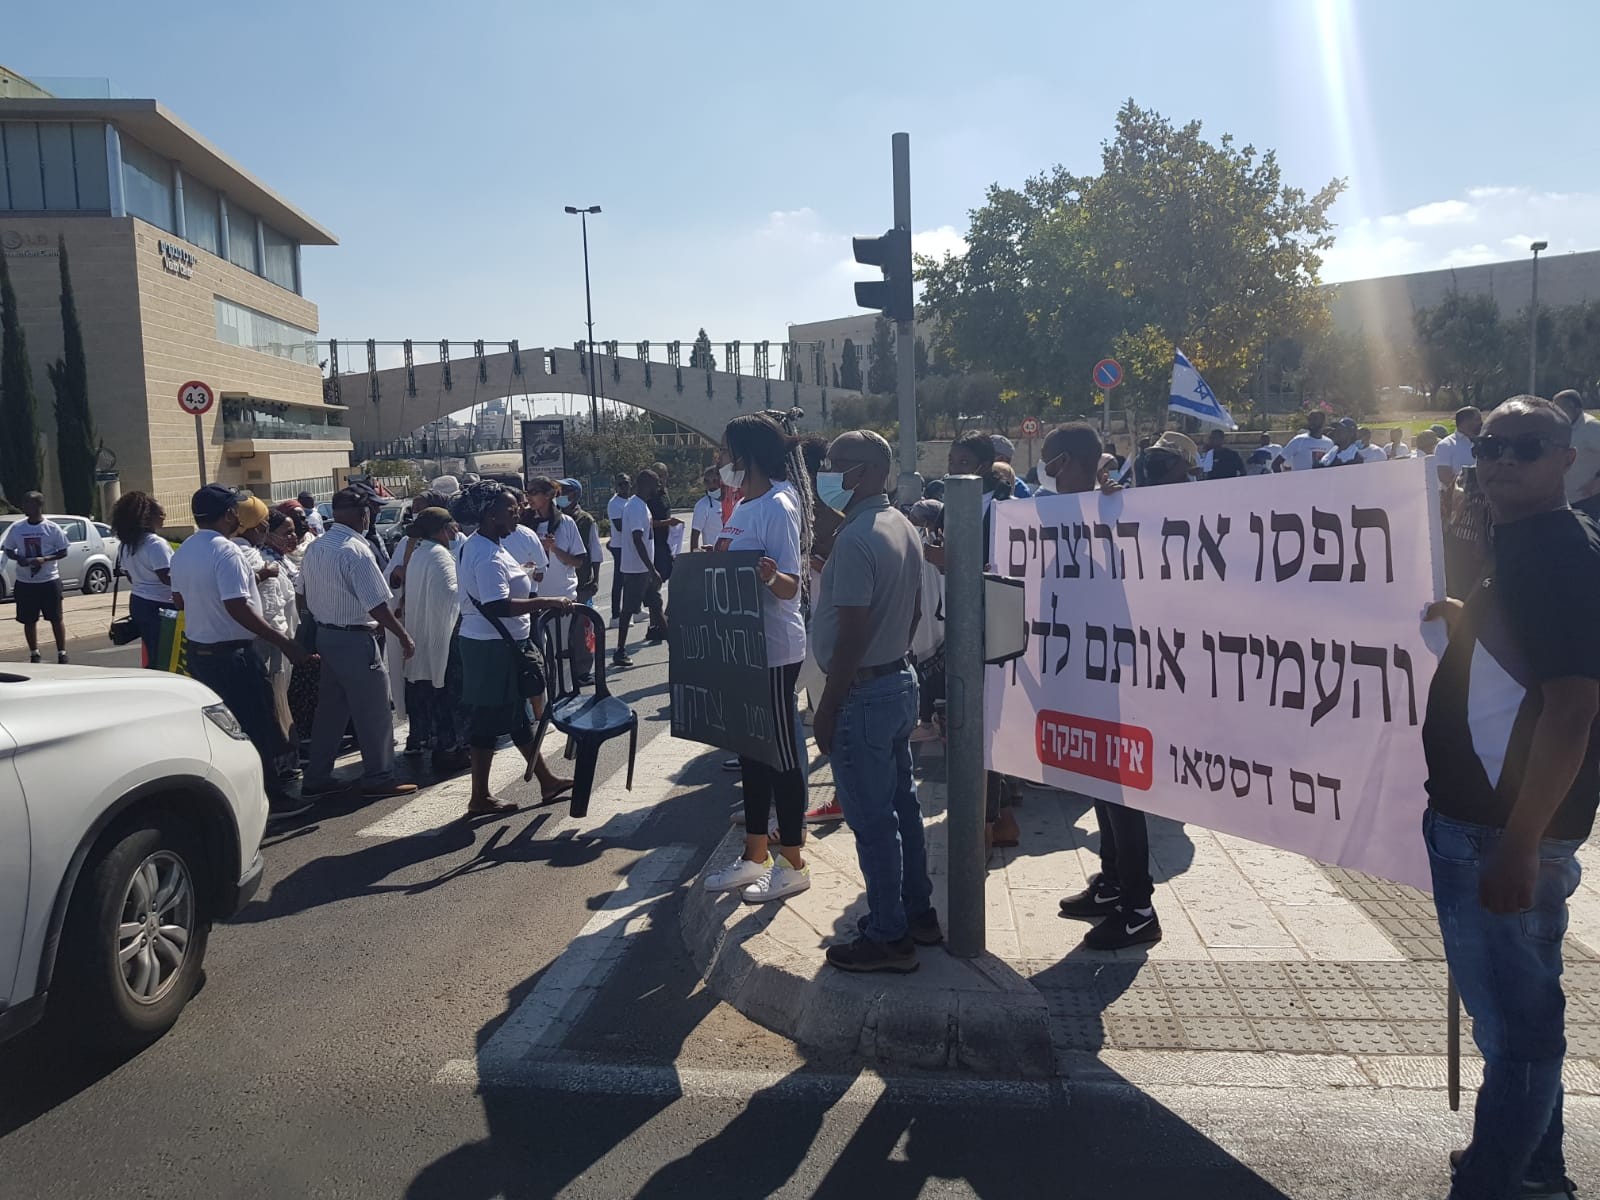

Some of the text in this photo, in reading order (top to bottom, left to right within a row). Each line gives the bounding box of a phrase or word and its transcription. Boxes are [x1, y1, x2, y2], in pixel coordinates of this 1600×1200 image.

[185, 392, 206, 404] 4.3
[1008, 518, 1145, 581] הרוצחים
[1160, 513, 1232, 582] את
[1249, 504, 1394, 584] תפסו
[704, 566, 761, 618] כנסת
[1085, 621, 1186, 695] אותם
[1201, 629, 1419, 728] והעמידו
[1041, 719, 1342, 821] דם דסטאו אינו הפקר!
